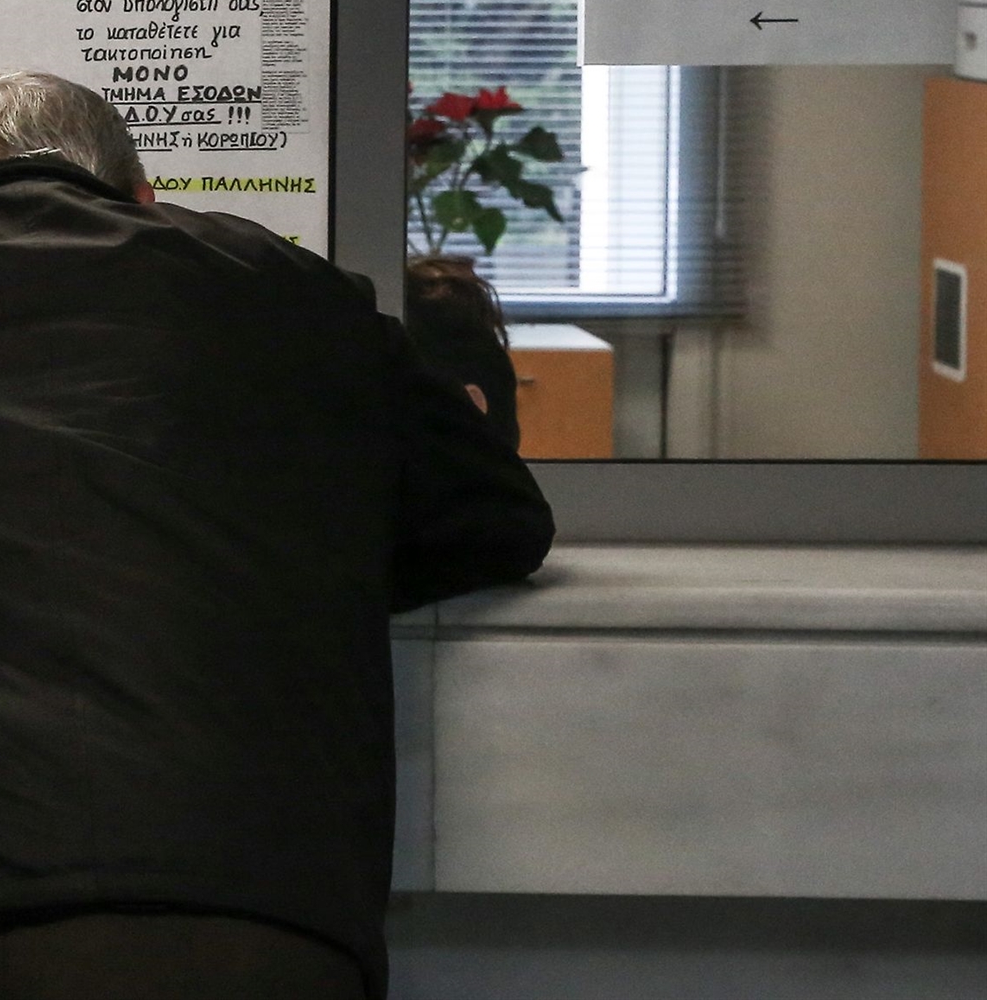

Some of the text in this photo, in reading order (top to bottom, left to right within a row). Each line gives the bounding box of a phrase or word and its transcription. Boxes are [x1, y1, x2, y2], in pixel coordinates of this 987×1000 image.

[76, 21, 241, 47] το καταθέτετε για
[81, 45, 212, 61] τακτοποίηση
[113, 65, 188, 82] ΜΟΝΟ
[102, 86, 262, 101] ΤΜΗΜΑ ΕΣΟΔΩΝ
[181, 108, 216, 121] σας
[131, 131, 179, 147] ΗΝΗΣ
[182, 133, 192, 147] ή
[202, 176, 316, 193] ΠΑΛΛΗΝΗΣ
